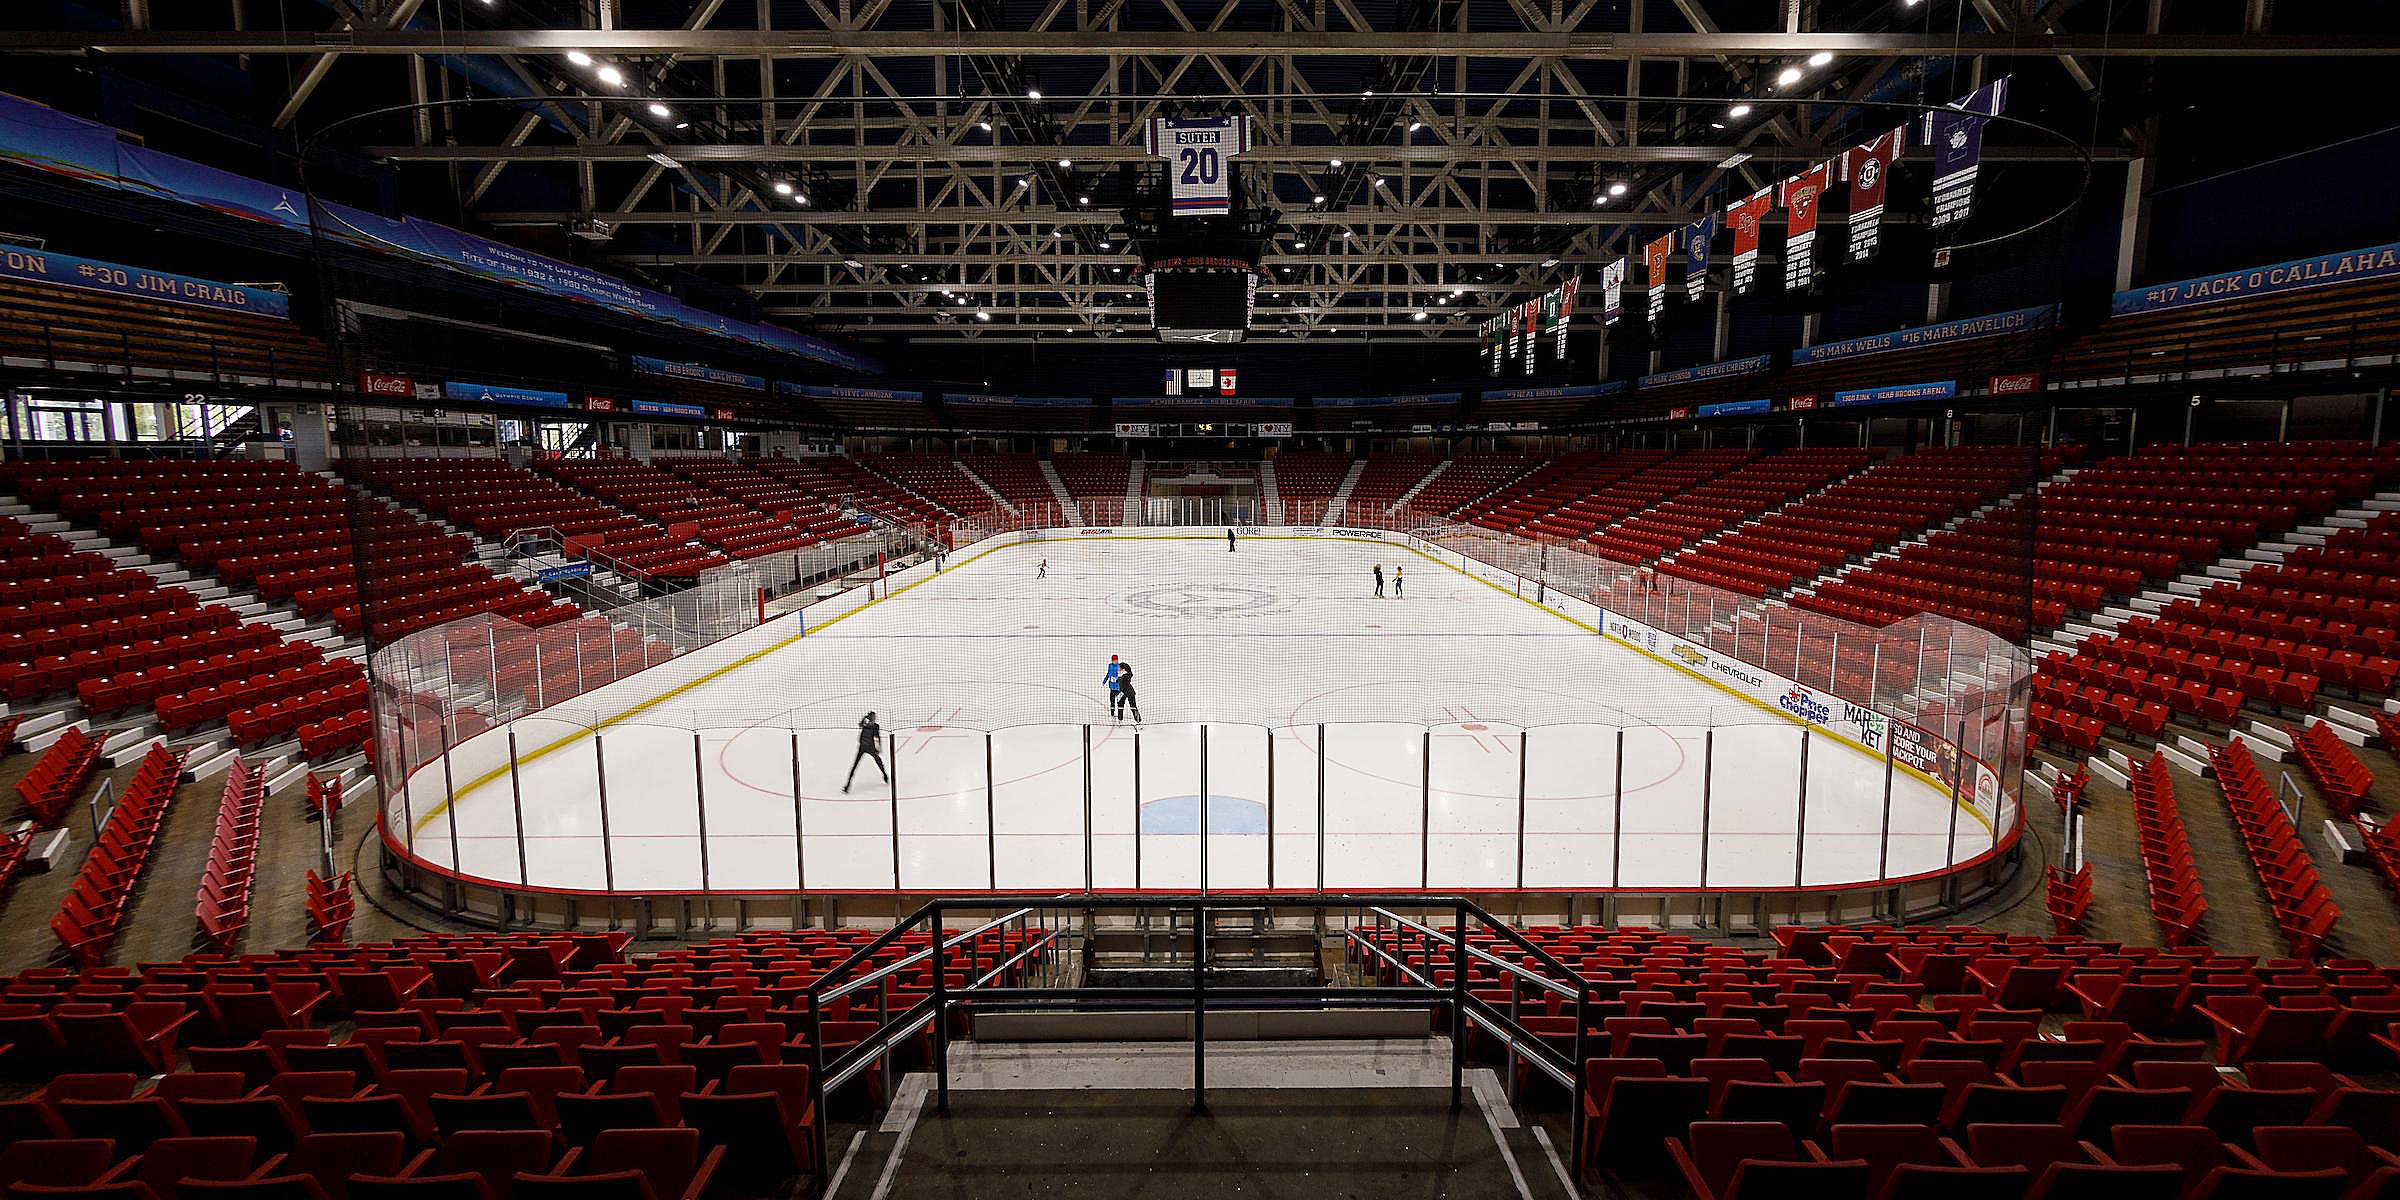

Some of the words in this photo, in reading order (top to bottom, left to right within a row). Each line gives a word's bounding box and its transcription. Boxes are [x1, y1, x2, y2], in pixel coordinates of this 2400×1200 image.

[1179, 132, 1217, 143] SUTER
[1180, 147, 1219, 185] 20
[1935, 195, 1970, 215] CHAMPIONS
[1931, 212, 1951, 227] 2009
[1953, 206, 1970, 220] 2011
[488, 246, 525, 264] WELCOME
[555, 265, 573, 276] LAKE
[501, 262, 519, 273] THE
[521, 267, 547, 280] 1932
[75, 264, 128, 286] #30
[136, 273, 178, 295] JIM
[184, 282, 246, 305] CRAIG
[2146, 286, 2179, 303] #17
[2184, 275, 2242, 299] JACK
[2248, 249, 2400, 289] O'CALLAHA
[1902, 332, 1921, 343] #16
[1923, 325, 1958, 341] MARK
[1961, 313, 2025, 335] PAVELICH
[1811, 348, 1825, 358] #15
[1827, 343, 1854, 356] MARK
[1855, 337, 1891, 352] WELLS
[373, 379, 406, 393] Coca-Cola
[2000, 376, 2034, 391] Coca-Cola
[184, 393, 205, 405] 22
[2190, 395, 2201, 406] 5
[433, 408, 445, 417] 21
[1946, 410, 1953, 418] 6
[1332, 529, 1383, 539] POWERADE
[1711, 660, 1763, 688] CHEVROLET
[1779, 694, 1829, 725] Chopper
[1800, 693, 1830, 716] Price
[1903, 727, 1921, 743] AND
[1915, 744, 1937, 764] YOUR
